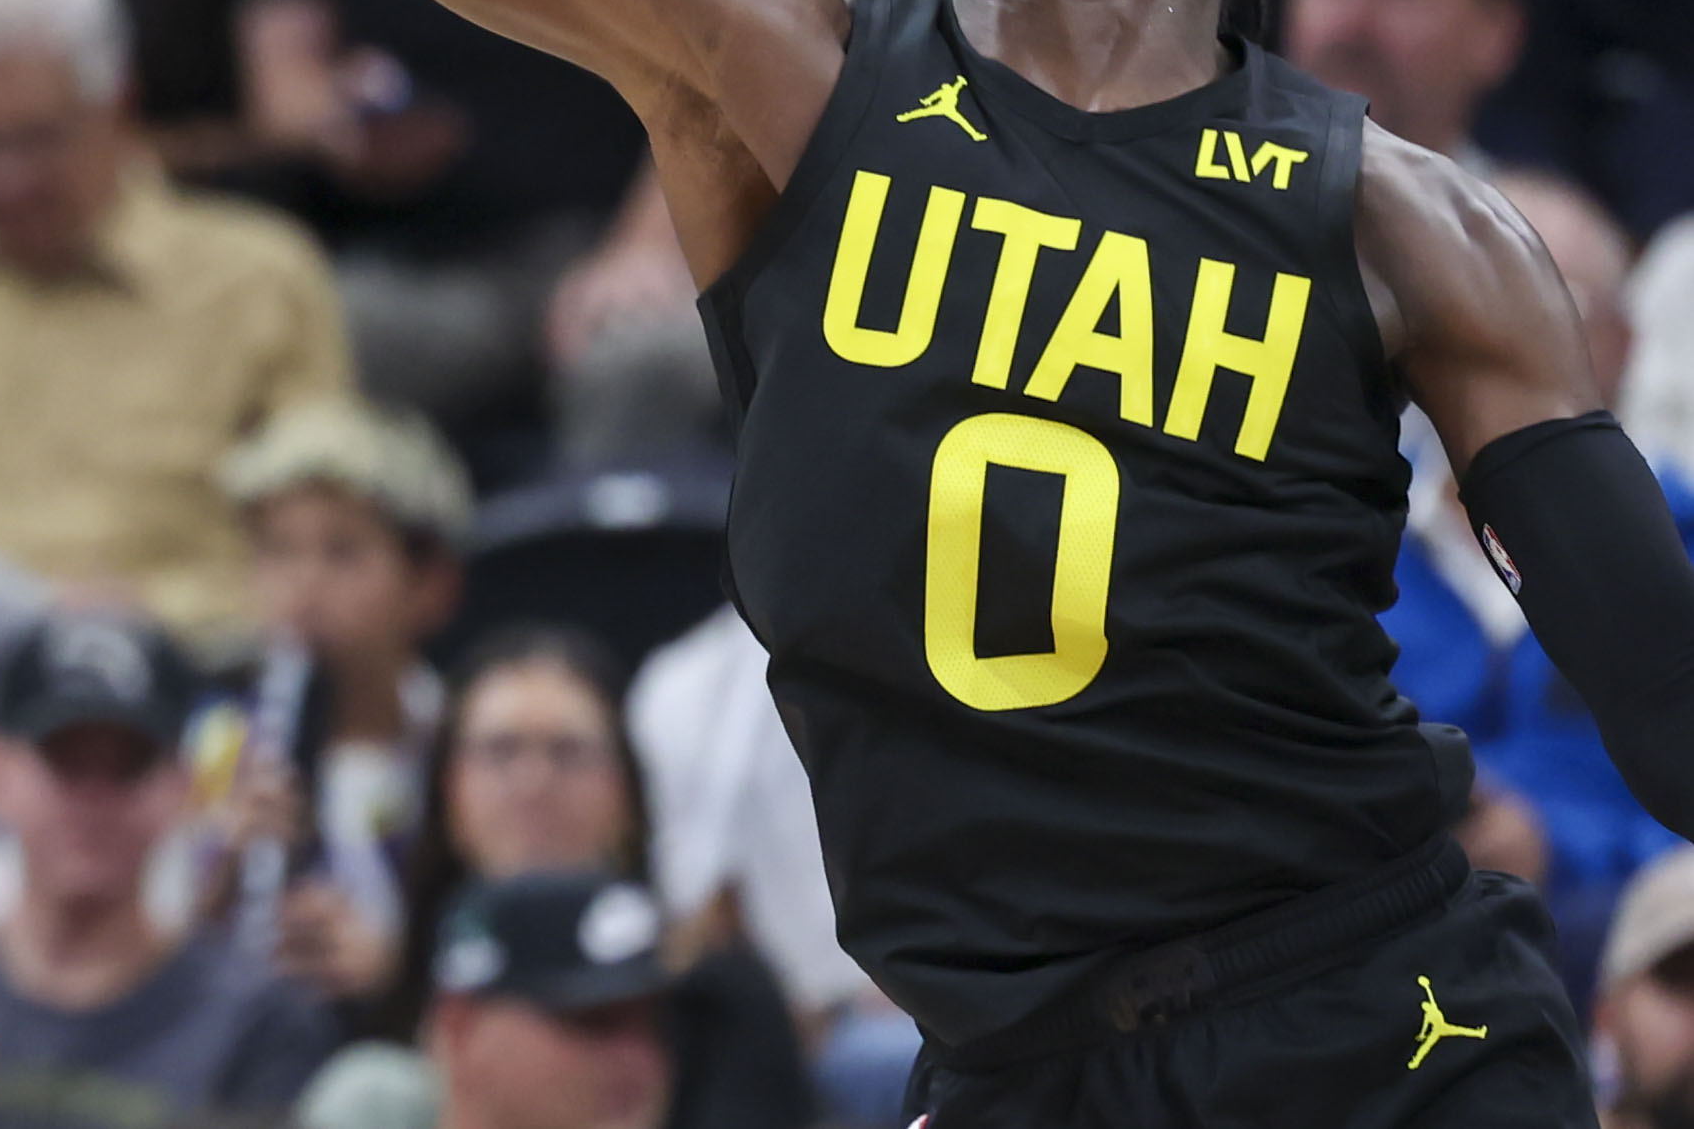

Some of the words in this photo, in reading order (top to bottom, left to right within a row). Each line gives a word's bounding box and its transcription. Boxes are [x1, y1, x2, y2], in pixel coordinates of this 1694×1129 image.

[1195, 128, 1309, 190] LVT
[822, 169, 1311, 462] UTAH
[924, 412, 1120, 712] 0
